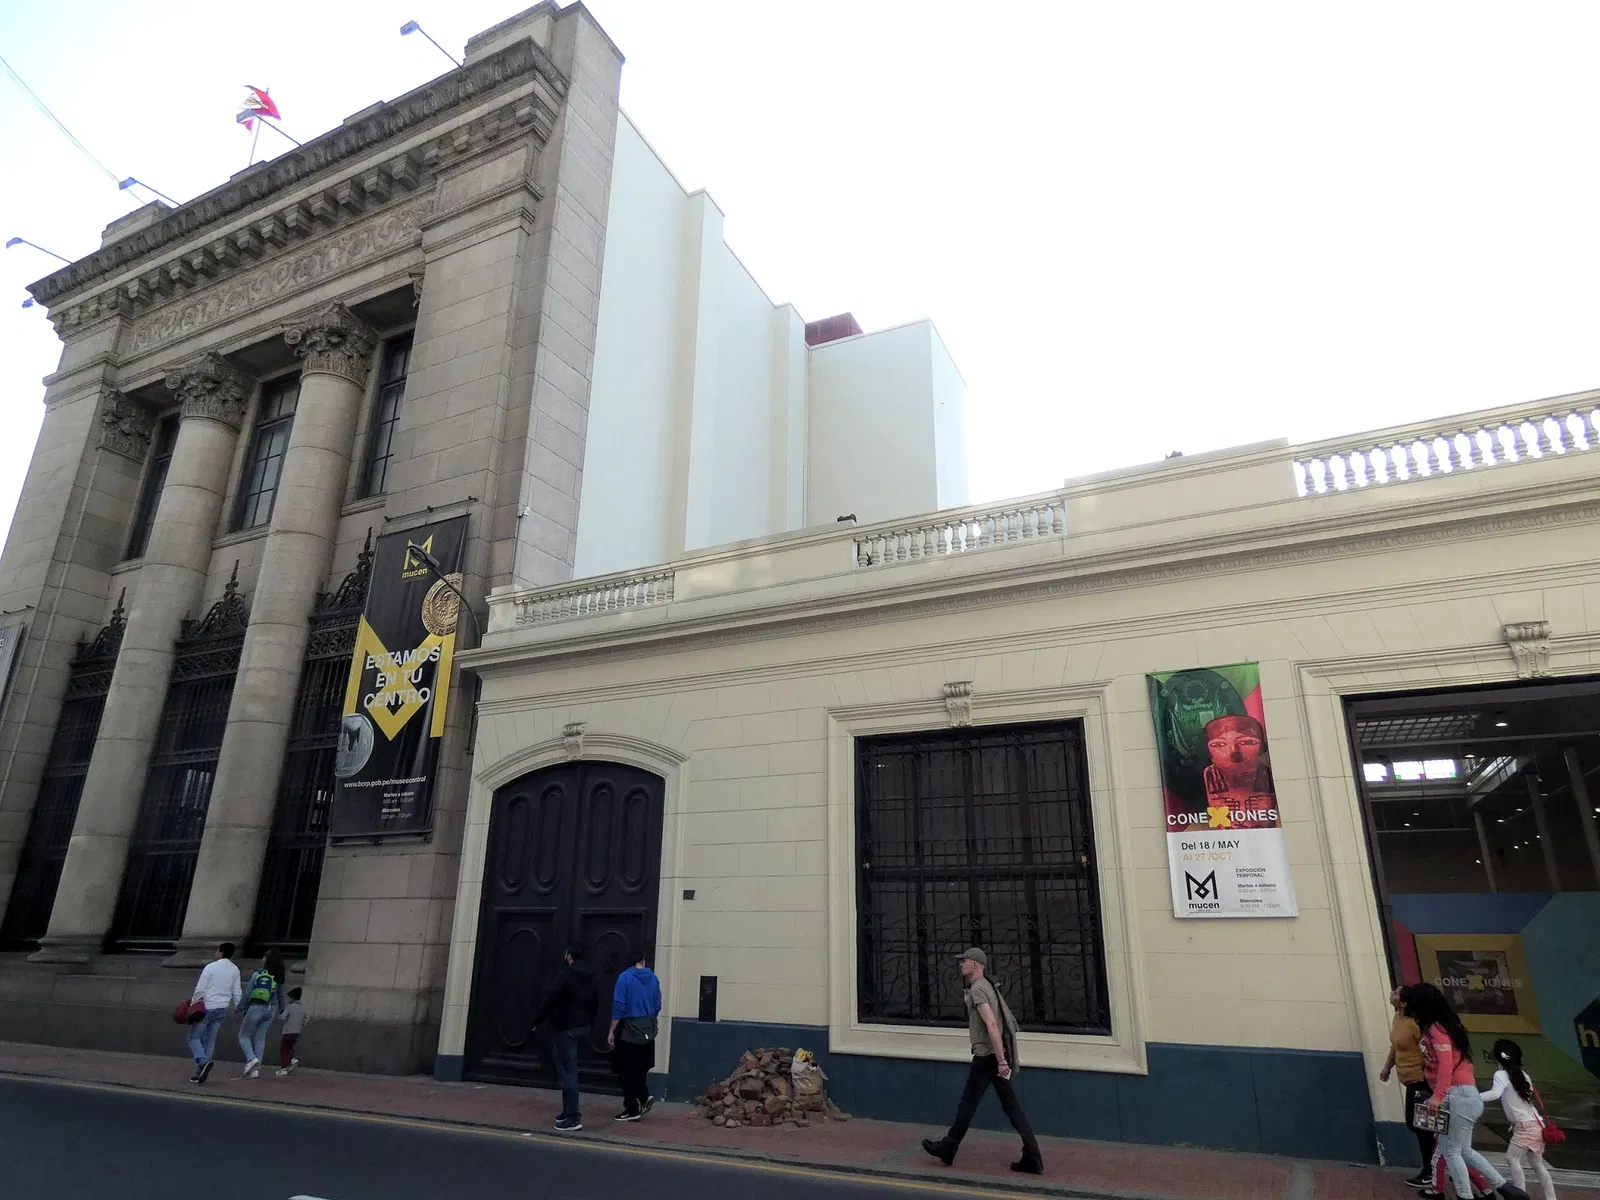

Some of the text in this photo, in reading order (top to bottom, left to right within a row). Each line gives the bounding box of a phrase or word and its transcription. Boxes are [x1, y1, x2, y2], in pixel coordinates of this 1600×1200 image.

[402, 567, 428, 579] mucen
[365, 646, 440, 670] ESTAMOS
[375, 667, 423, 688] EN TU
[363, 687, 431, 709] CENTRO
[1181, 842, 1197, 850] Del
[1199, 841, 1210, 850] 18
[1218, 840, 1240, 849] MAY
[1195, 853, 1205, 861] 27
